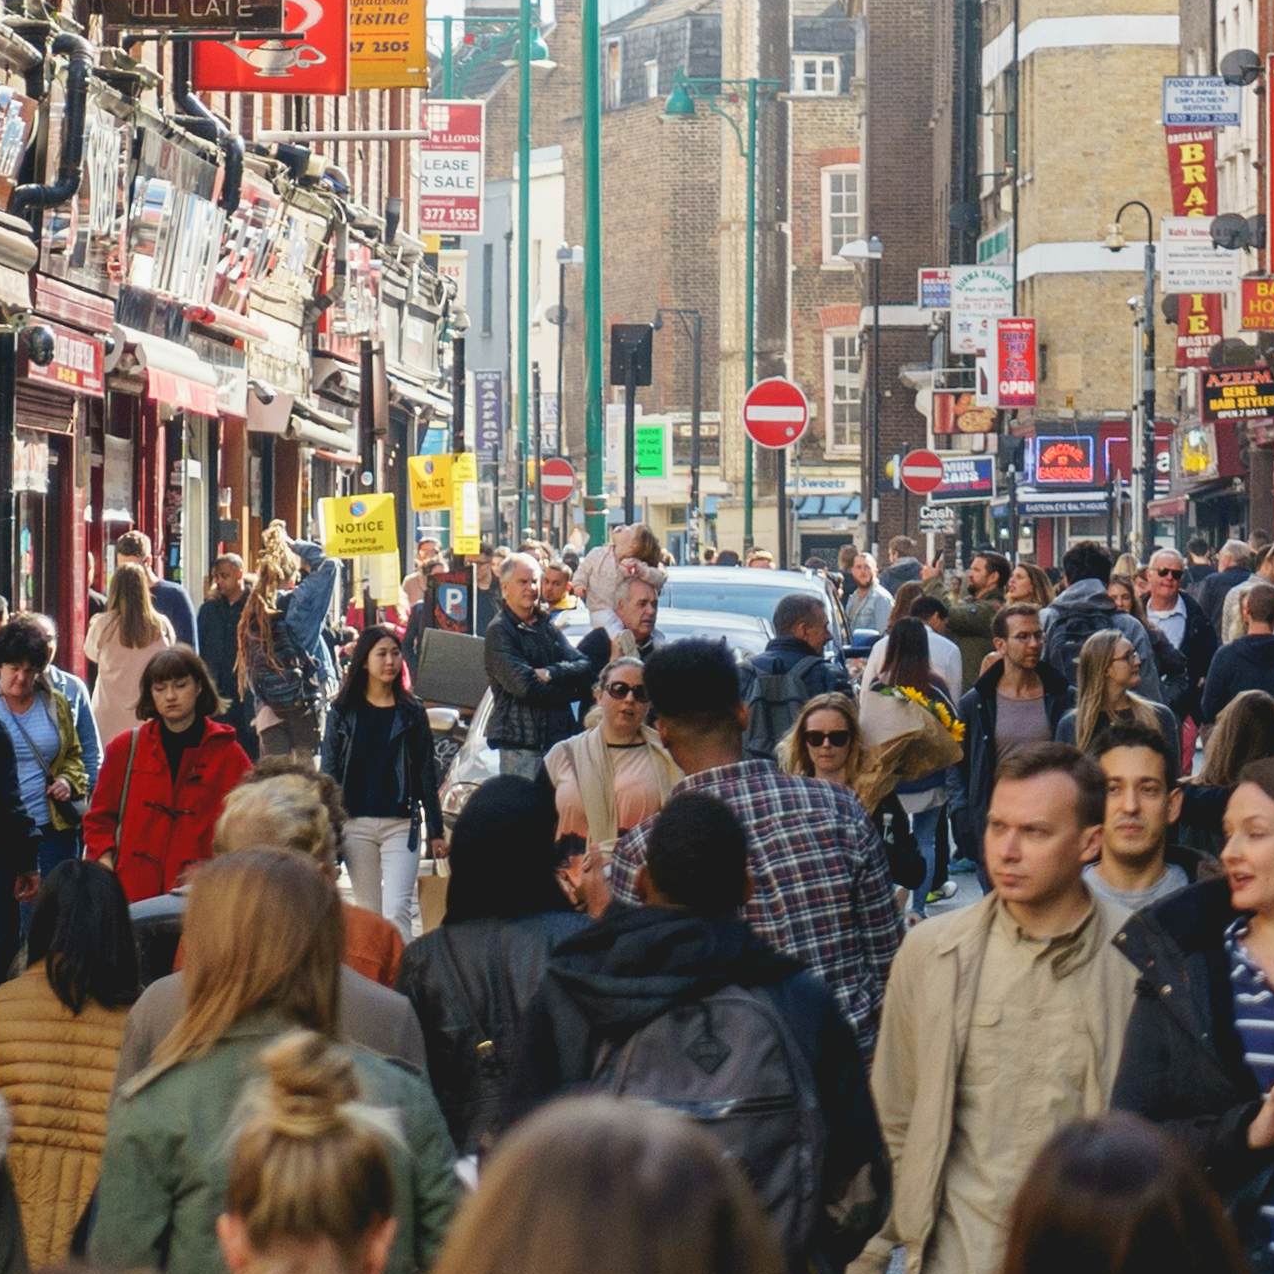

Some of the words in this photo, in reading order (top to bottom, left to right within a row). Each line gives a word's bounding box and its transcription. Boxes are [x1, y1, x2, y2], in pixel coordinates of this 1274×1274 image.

[442, 134, 481, 143] LLOYDS
[424, 159, 470, 171] LEASE
[434, 176, 476, 189] SALE
[424, 209, 445, 221] 377
[449, 209, 477, 221] 1555
[999, 381, 1035, 394] OPEN
[1222, 385, 1258, 397] GENTS
[920, 506, 955, 519] Cash
[335, 521, 384, 534] NOTICE
[445, 588, 463, 614] P
